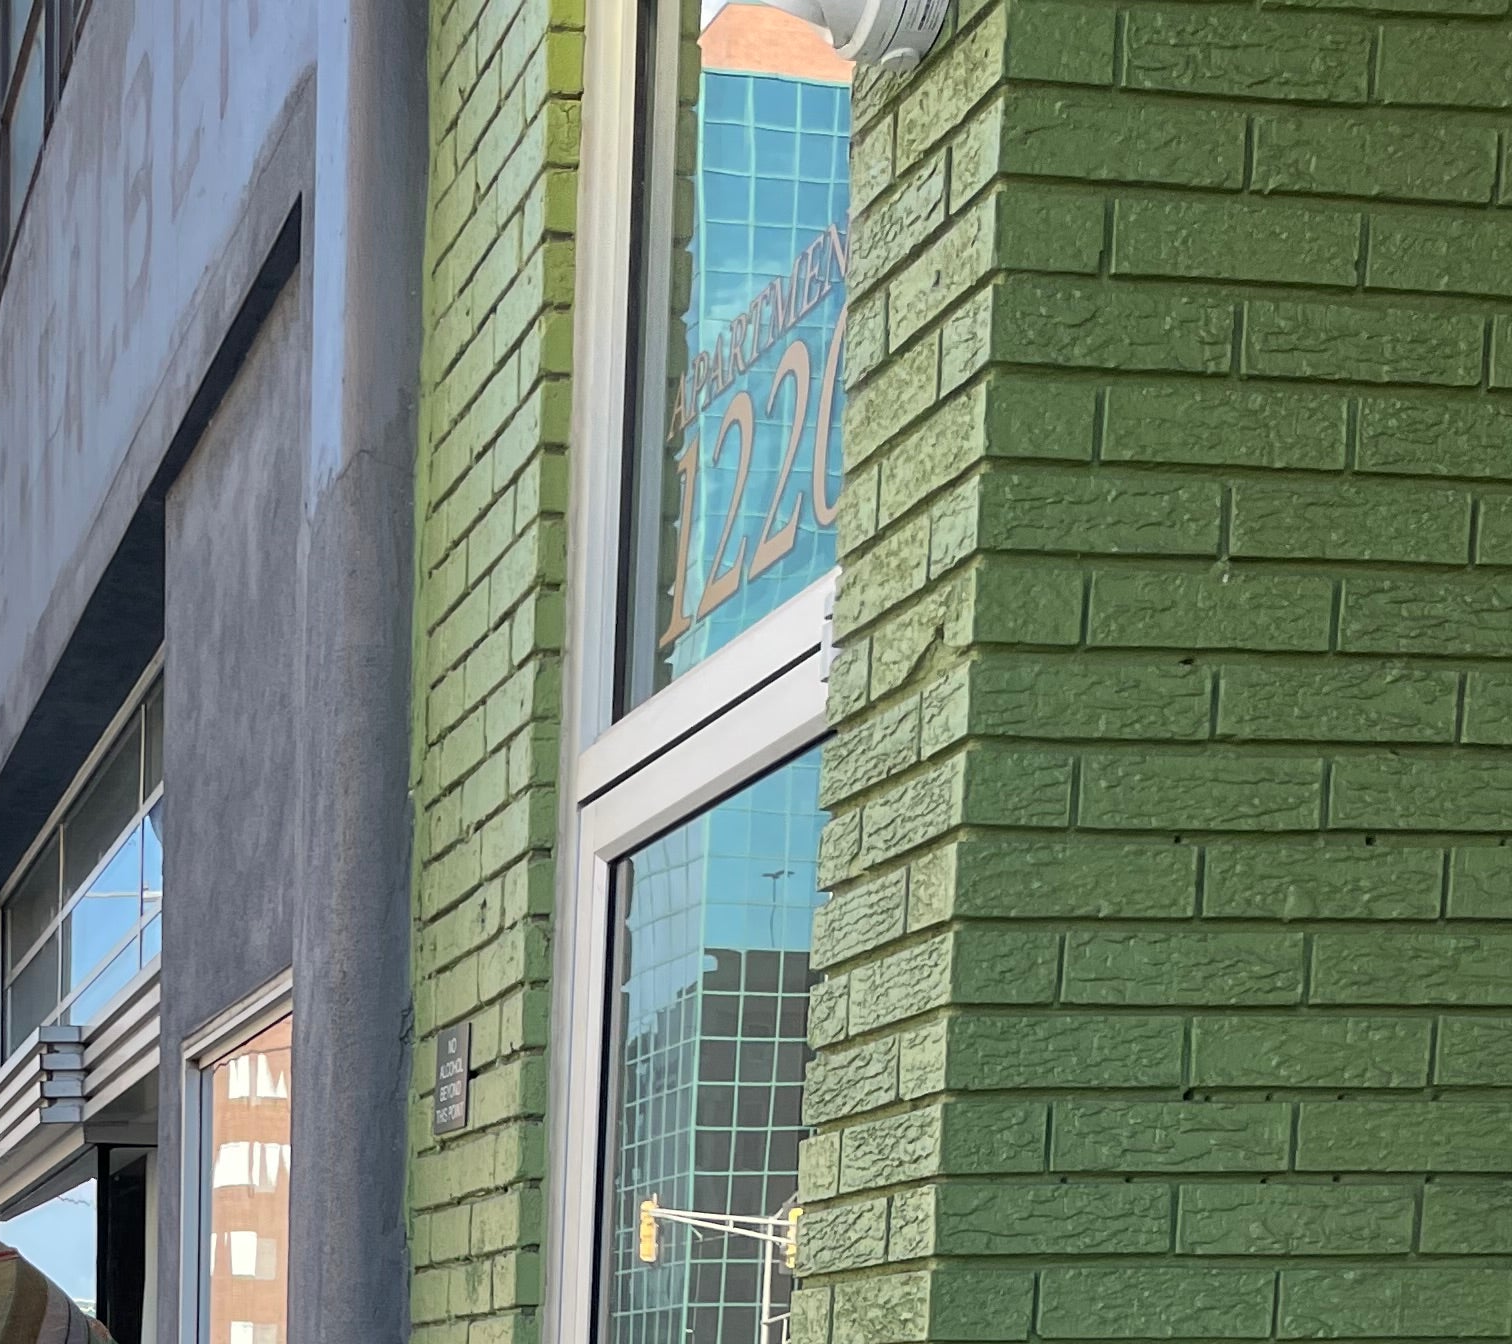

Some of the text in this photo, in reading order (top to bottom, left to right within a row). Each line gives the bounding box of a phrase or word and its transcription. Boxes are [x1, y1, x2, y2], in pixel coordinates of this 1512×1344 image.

[448, 1037, 457, 1054] NO
[440, 1057, 463, 1080] ALCOHOL
[439, 1080, 461, 1102] BEYOND
[436, 1101, 465, 1124] THIS POINT
